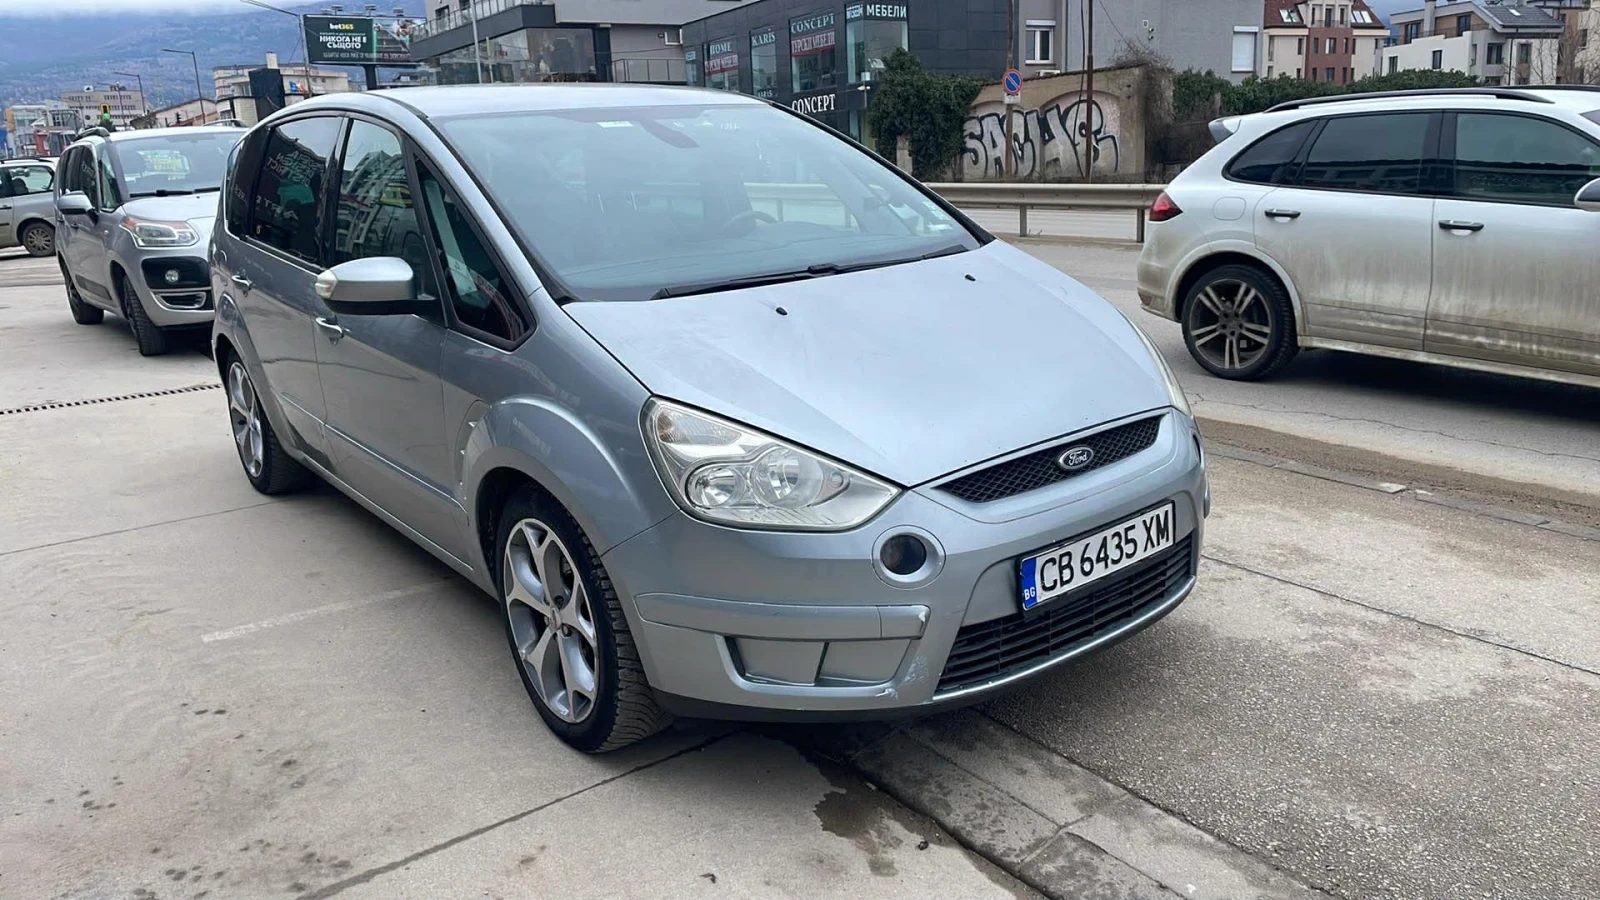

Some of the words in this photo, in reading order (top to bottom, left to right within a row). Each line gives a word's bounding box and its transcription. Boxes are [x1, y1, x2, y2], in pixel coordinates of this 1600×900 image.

[866, 4, 907, 18] МЕБЕЛИ
[791, 13, 835, 34] CONCEPT
[327, 41, 362, 49] СЪЩОТО
[792, 94, 835, 114] CONCEPT
[1068, 450, 1088, 466] Ford
[1040, 550, 1074, 592] CB
[1080, 524, 1138, 577] 6435
[1142, 509, 1170, 552] XM
[1023, 587, 1036, 600] BG
